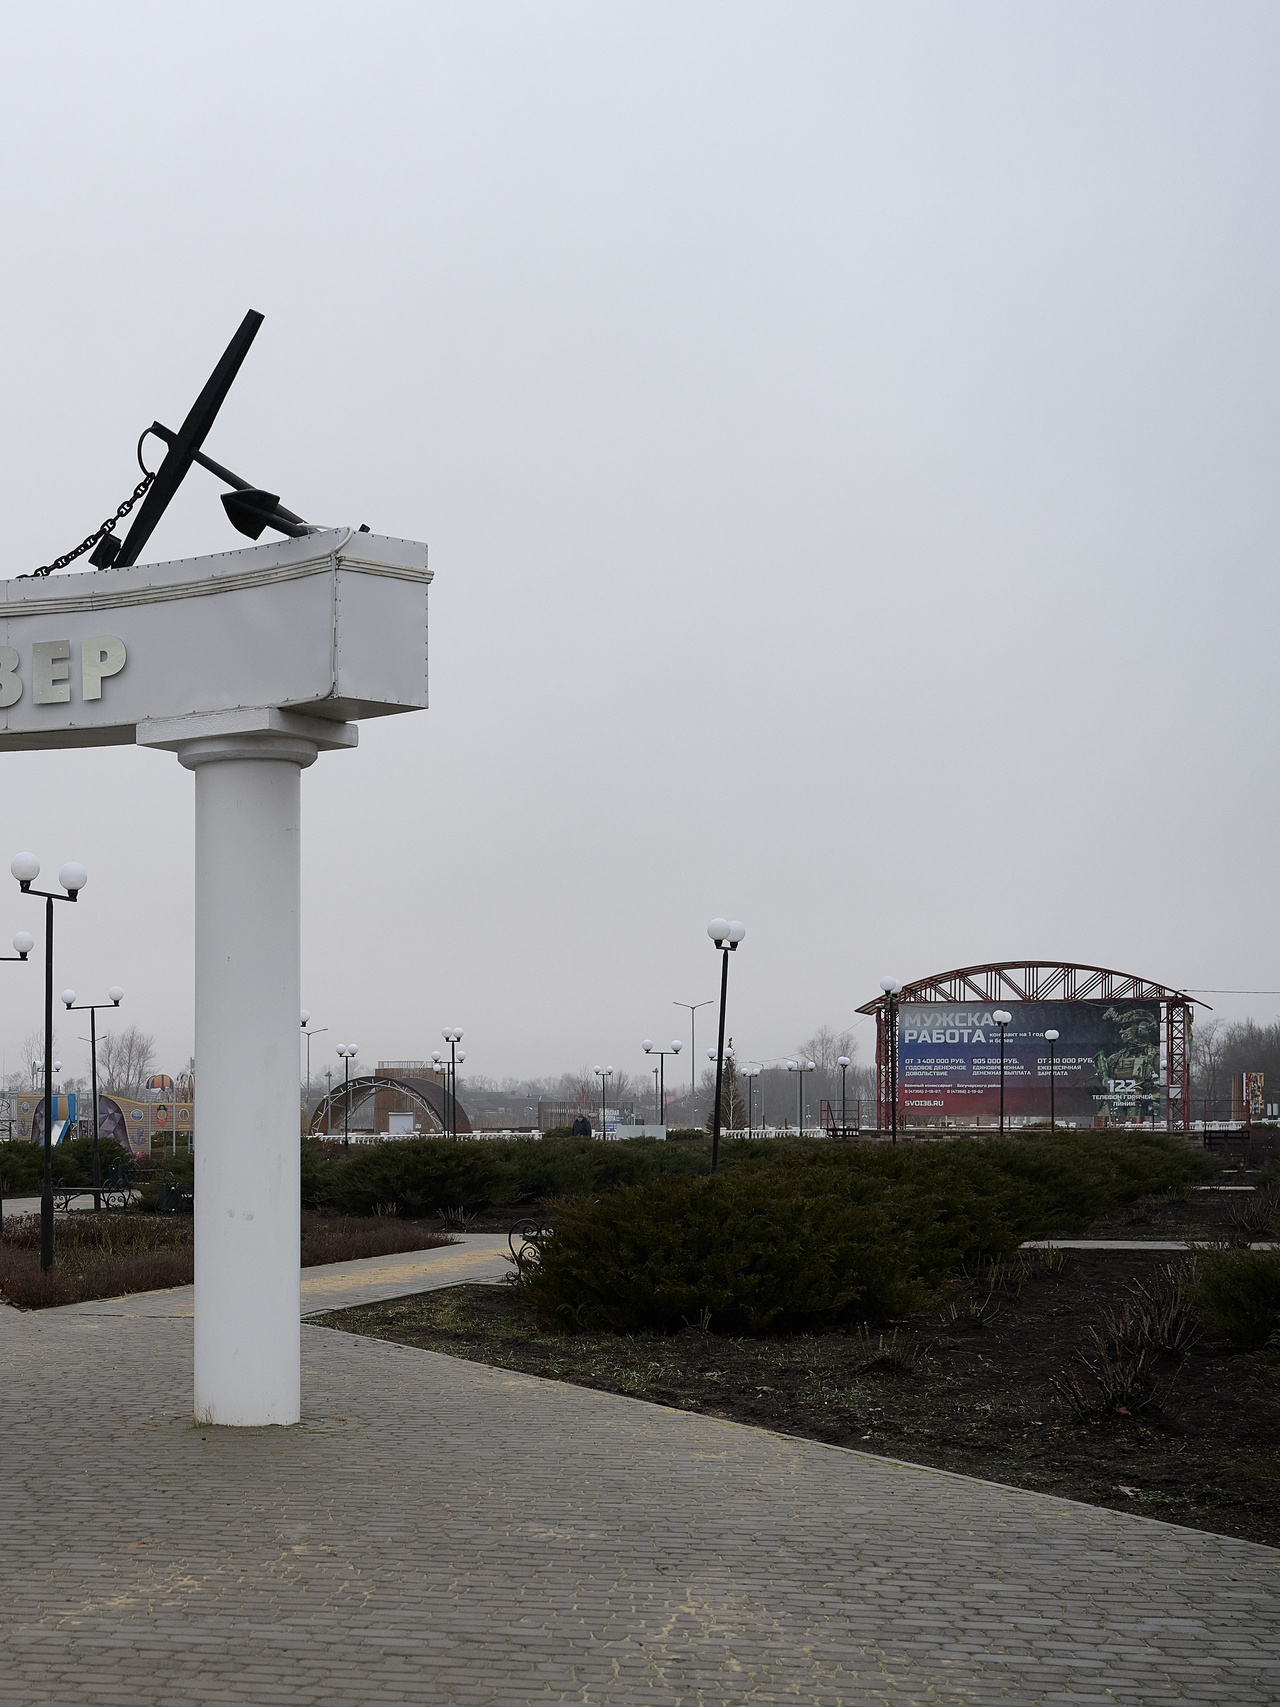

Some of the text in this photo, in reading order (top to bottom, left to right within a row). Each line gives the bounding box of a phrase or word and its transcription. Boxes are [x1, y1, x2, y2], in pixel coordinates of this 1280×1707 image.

[905, 1012, 1001, 1026] МУЖСКА
[905, 1029, 986, 1043] РАБОТА
[1107, 1079, 1136, 1093] 122
